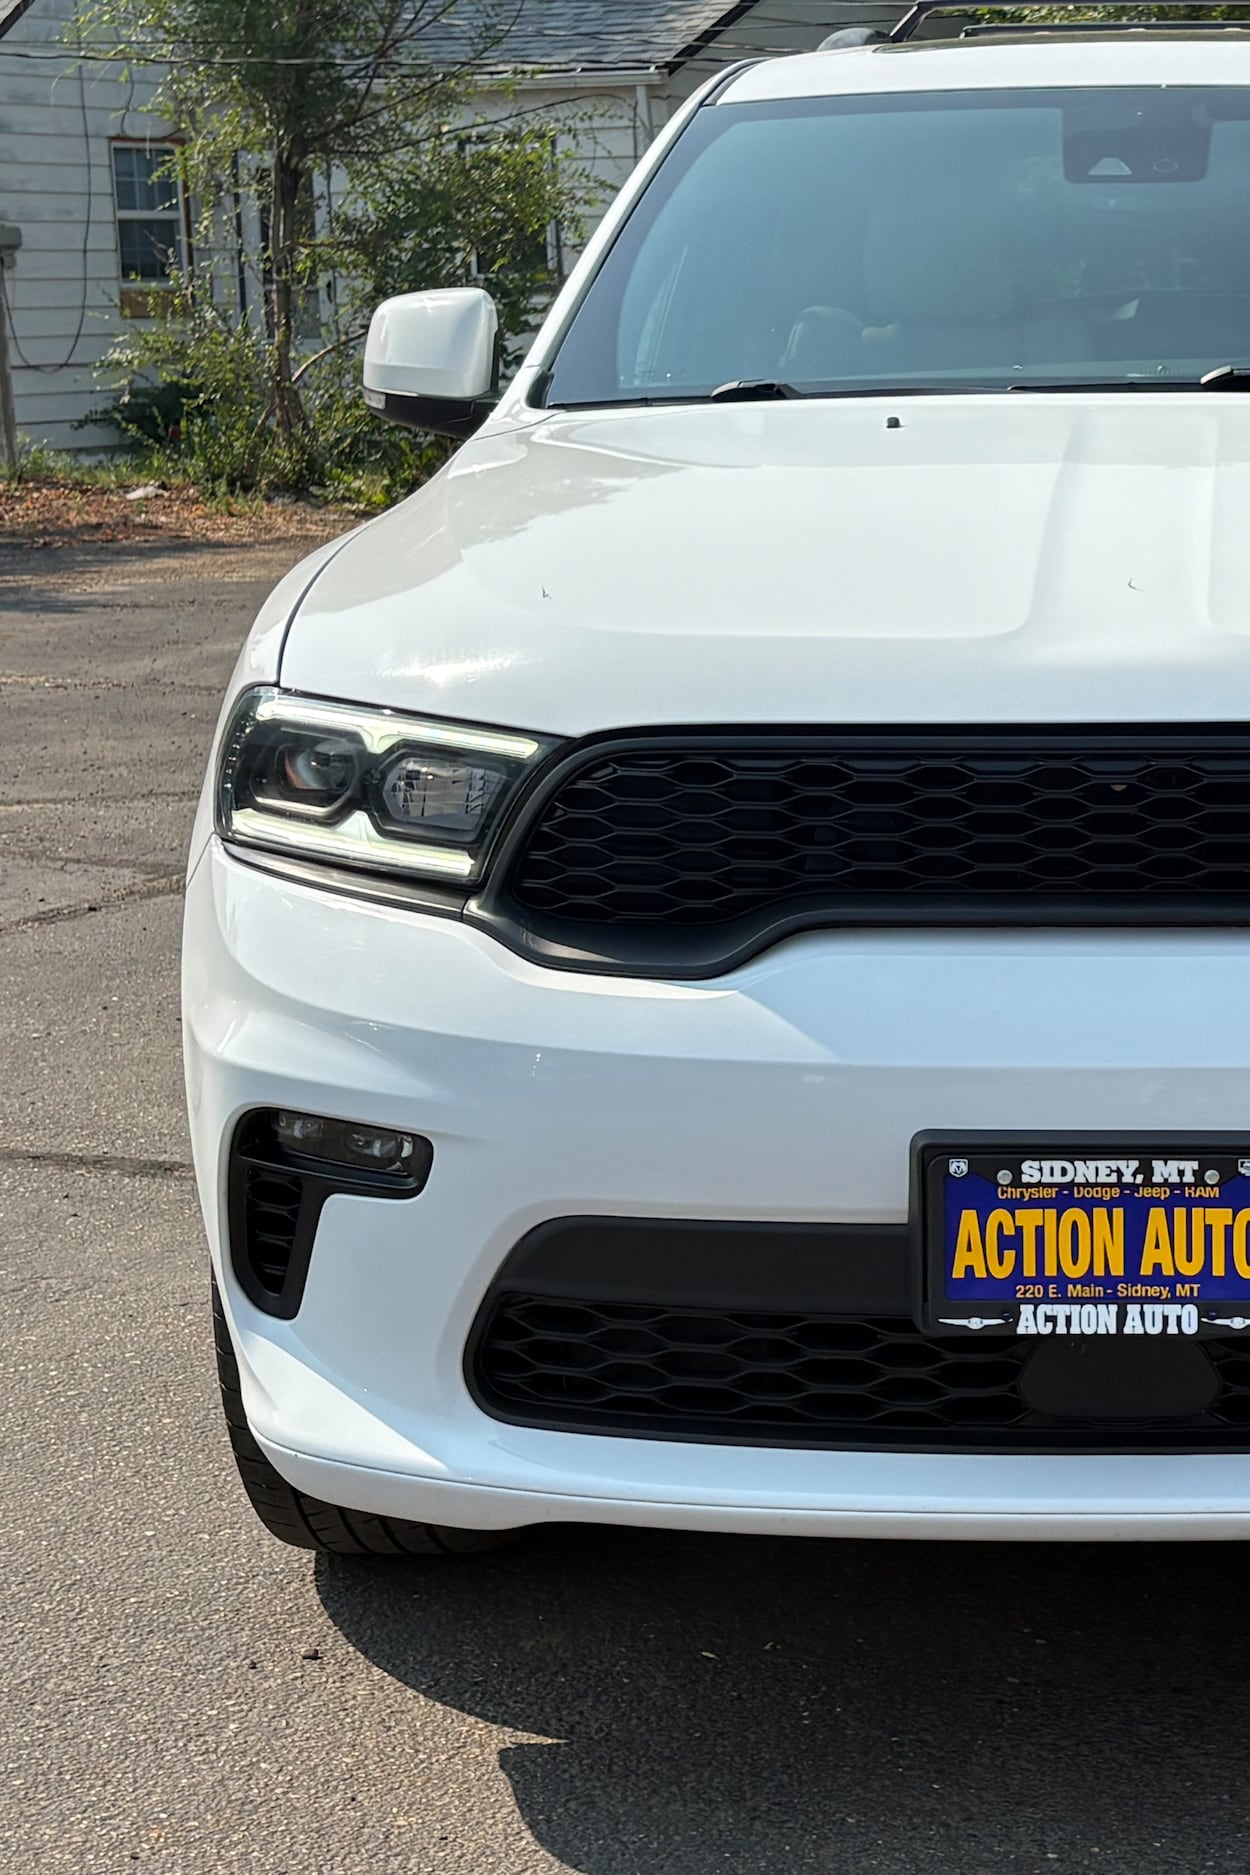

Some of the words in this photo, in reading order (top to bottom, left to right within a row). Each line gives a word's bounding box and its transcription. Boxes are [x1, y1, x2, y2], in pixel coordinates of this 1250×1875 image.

[1021, 1160, 1144, 1184] SIDNEY,
[1151, 1160, 1199, 1183] MT
[997, 1186, 1058, 1201] Chrysler
[1073, 1187, 1120, 1200] Dodge
[1134, 1187, 1170, 1200] Jeep
[1185, 1187, 1220, 1198] RAM
[952, 1208, 1124, 1279] ACTION
[1016, 1285, 1044, 1298] 220
[1049, 1285, 1061, 1298] E.
[1067, 1284, 1104, 1297] Main
[1117, 1283, 1171, 1299] Sidney,
[1176, 1284, 1201, 1297] MT
[1016, 1304, 1118, 1335] ACTION
[1123, 1304, 1199, 1335] AUTO
